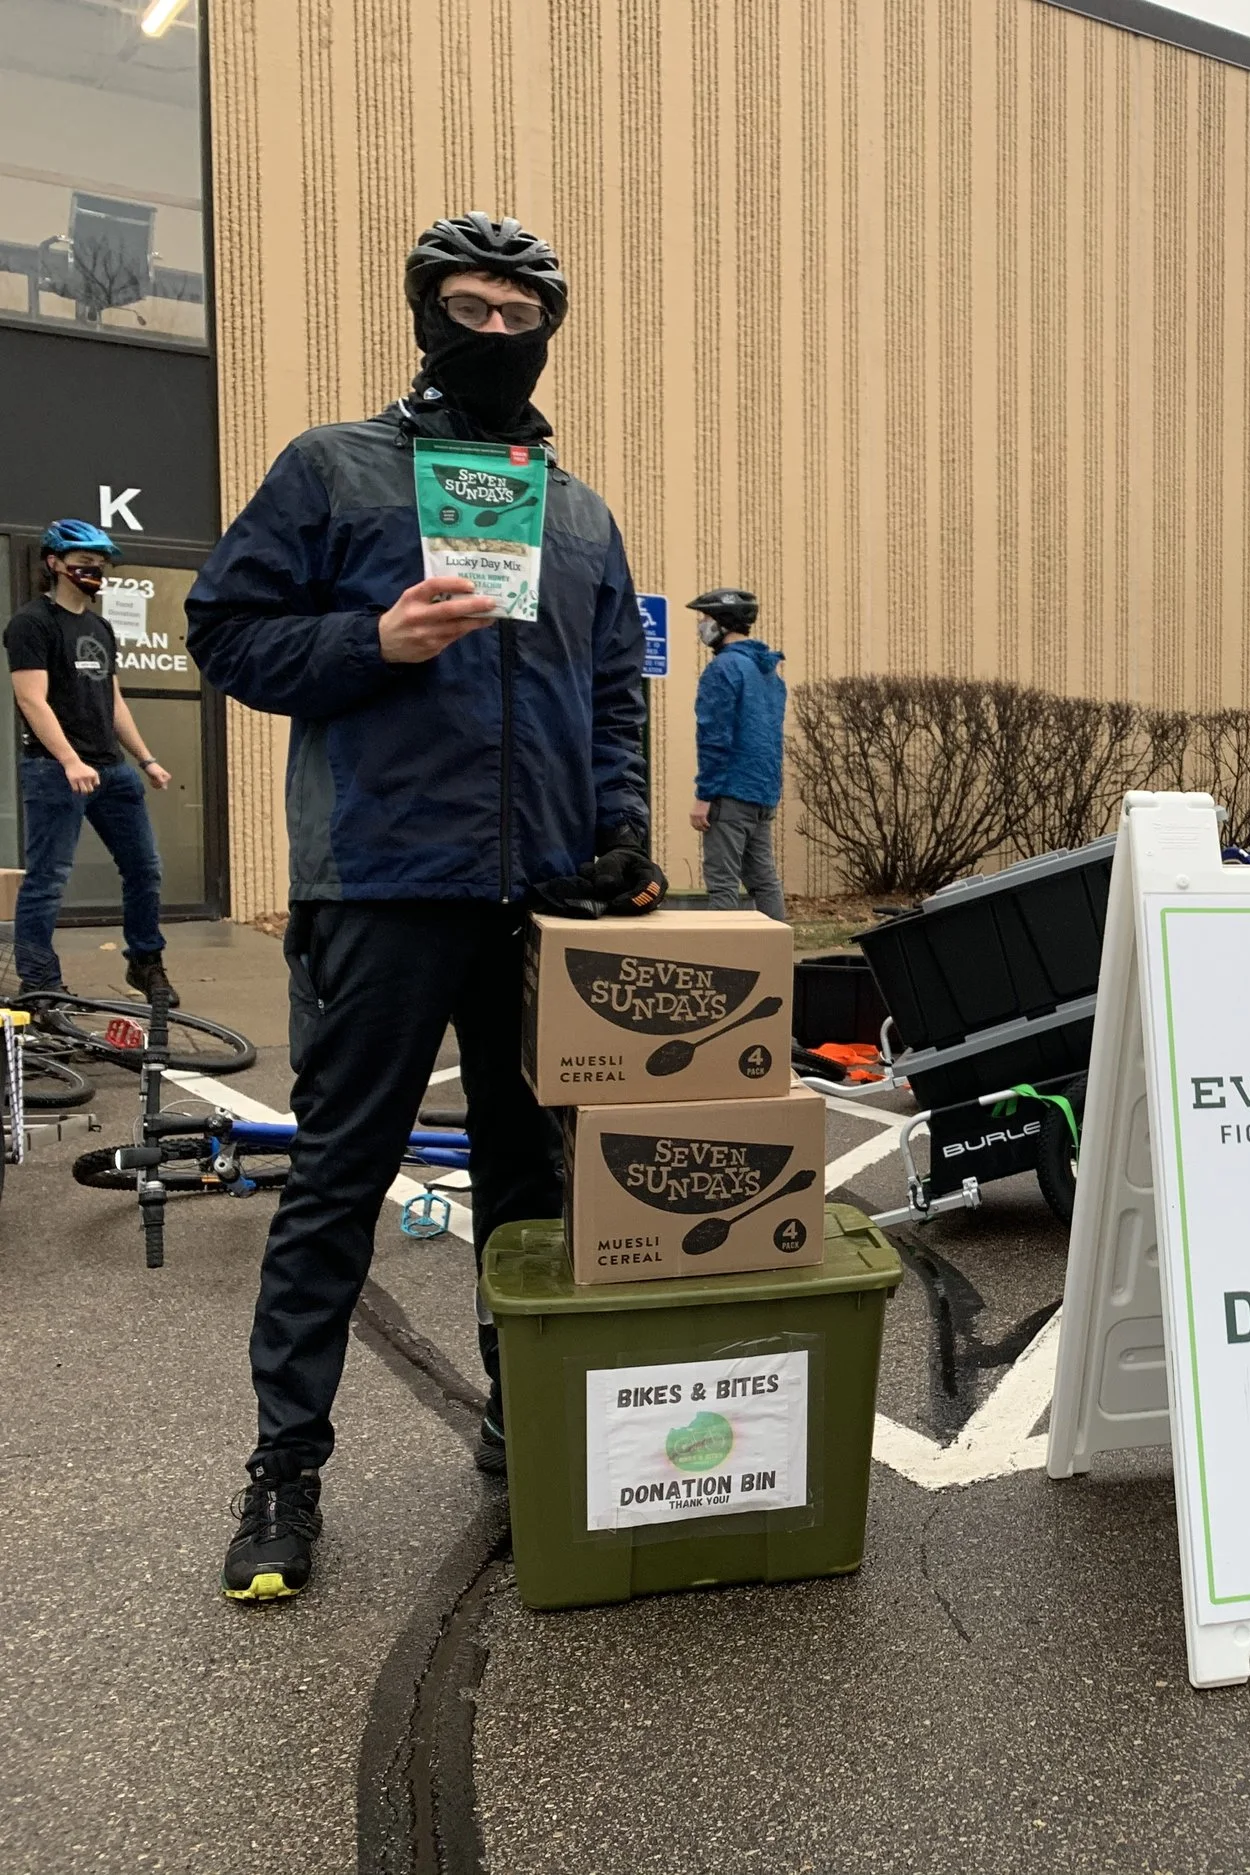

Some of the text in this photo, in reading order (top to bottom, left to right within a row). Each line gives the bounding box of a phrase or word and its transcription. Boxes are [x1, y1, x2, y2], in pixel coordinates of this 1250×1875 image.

[459, 469, 507, 487] SEVEN
[445, 479, 514, 503] SUNDAYS
[99, 485, 143, 531] K
[446, 556, 521, 571] Lucky Day Mix
[96, 577, 155, 598] 2723
[136, 631, 168, 649] AN
[619, 957, 713, 988] SEVEN
[590, 980, 727, 1021] SUNDAYS
[560, 1055, 623, 1067] MUESLI
[748, 1047, 763, 1065] 4
[560, 1070, 626, 1083] CEREAL
[746, 1067, 765, 1076] PACK
[654, 1139, 747, 1168] SEVEN
[627, 1163, 760, 1200] SUNDAYS
[782, 1221, 798, 1239] 4
[598, 1237, 660, 1250] MUESLI
[782, 1241, 799, 1250] PACK
[597, 1252, 663, 1266] CEREAL
[617, 1374, 779, 1408] BIKES & BITES
[620, 1470, 776, 1507] DONATION BIN
[669, 1495, 730, 1510] THANK YOU!
